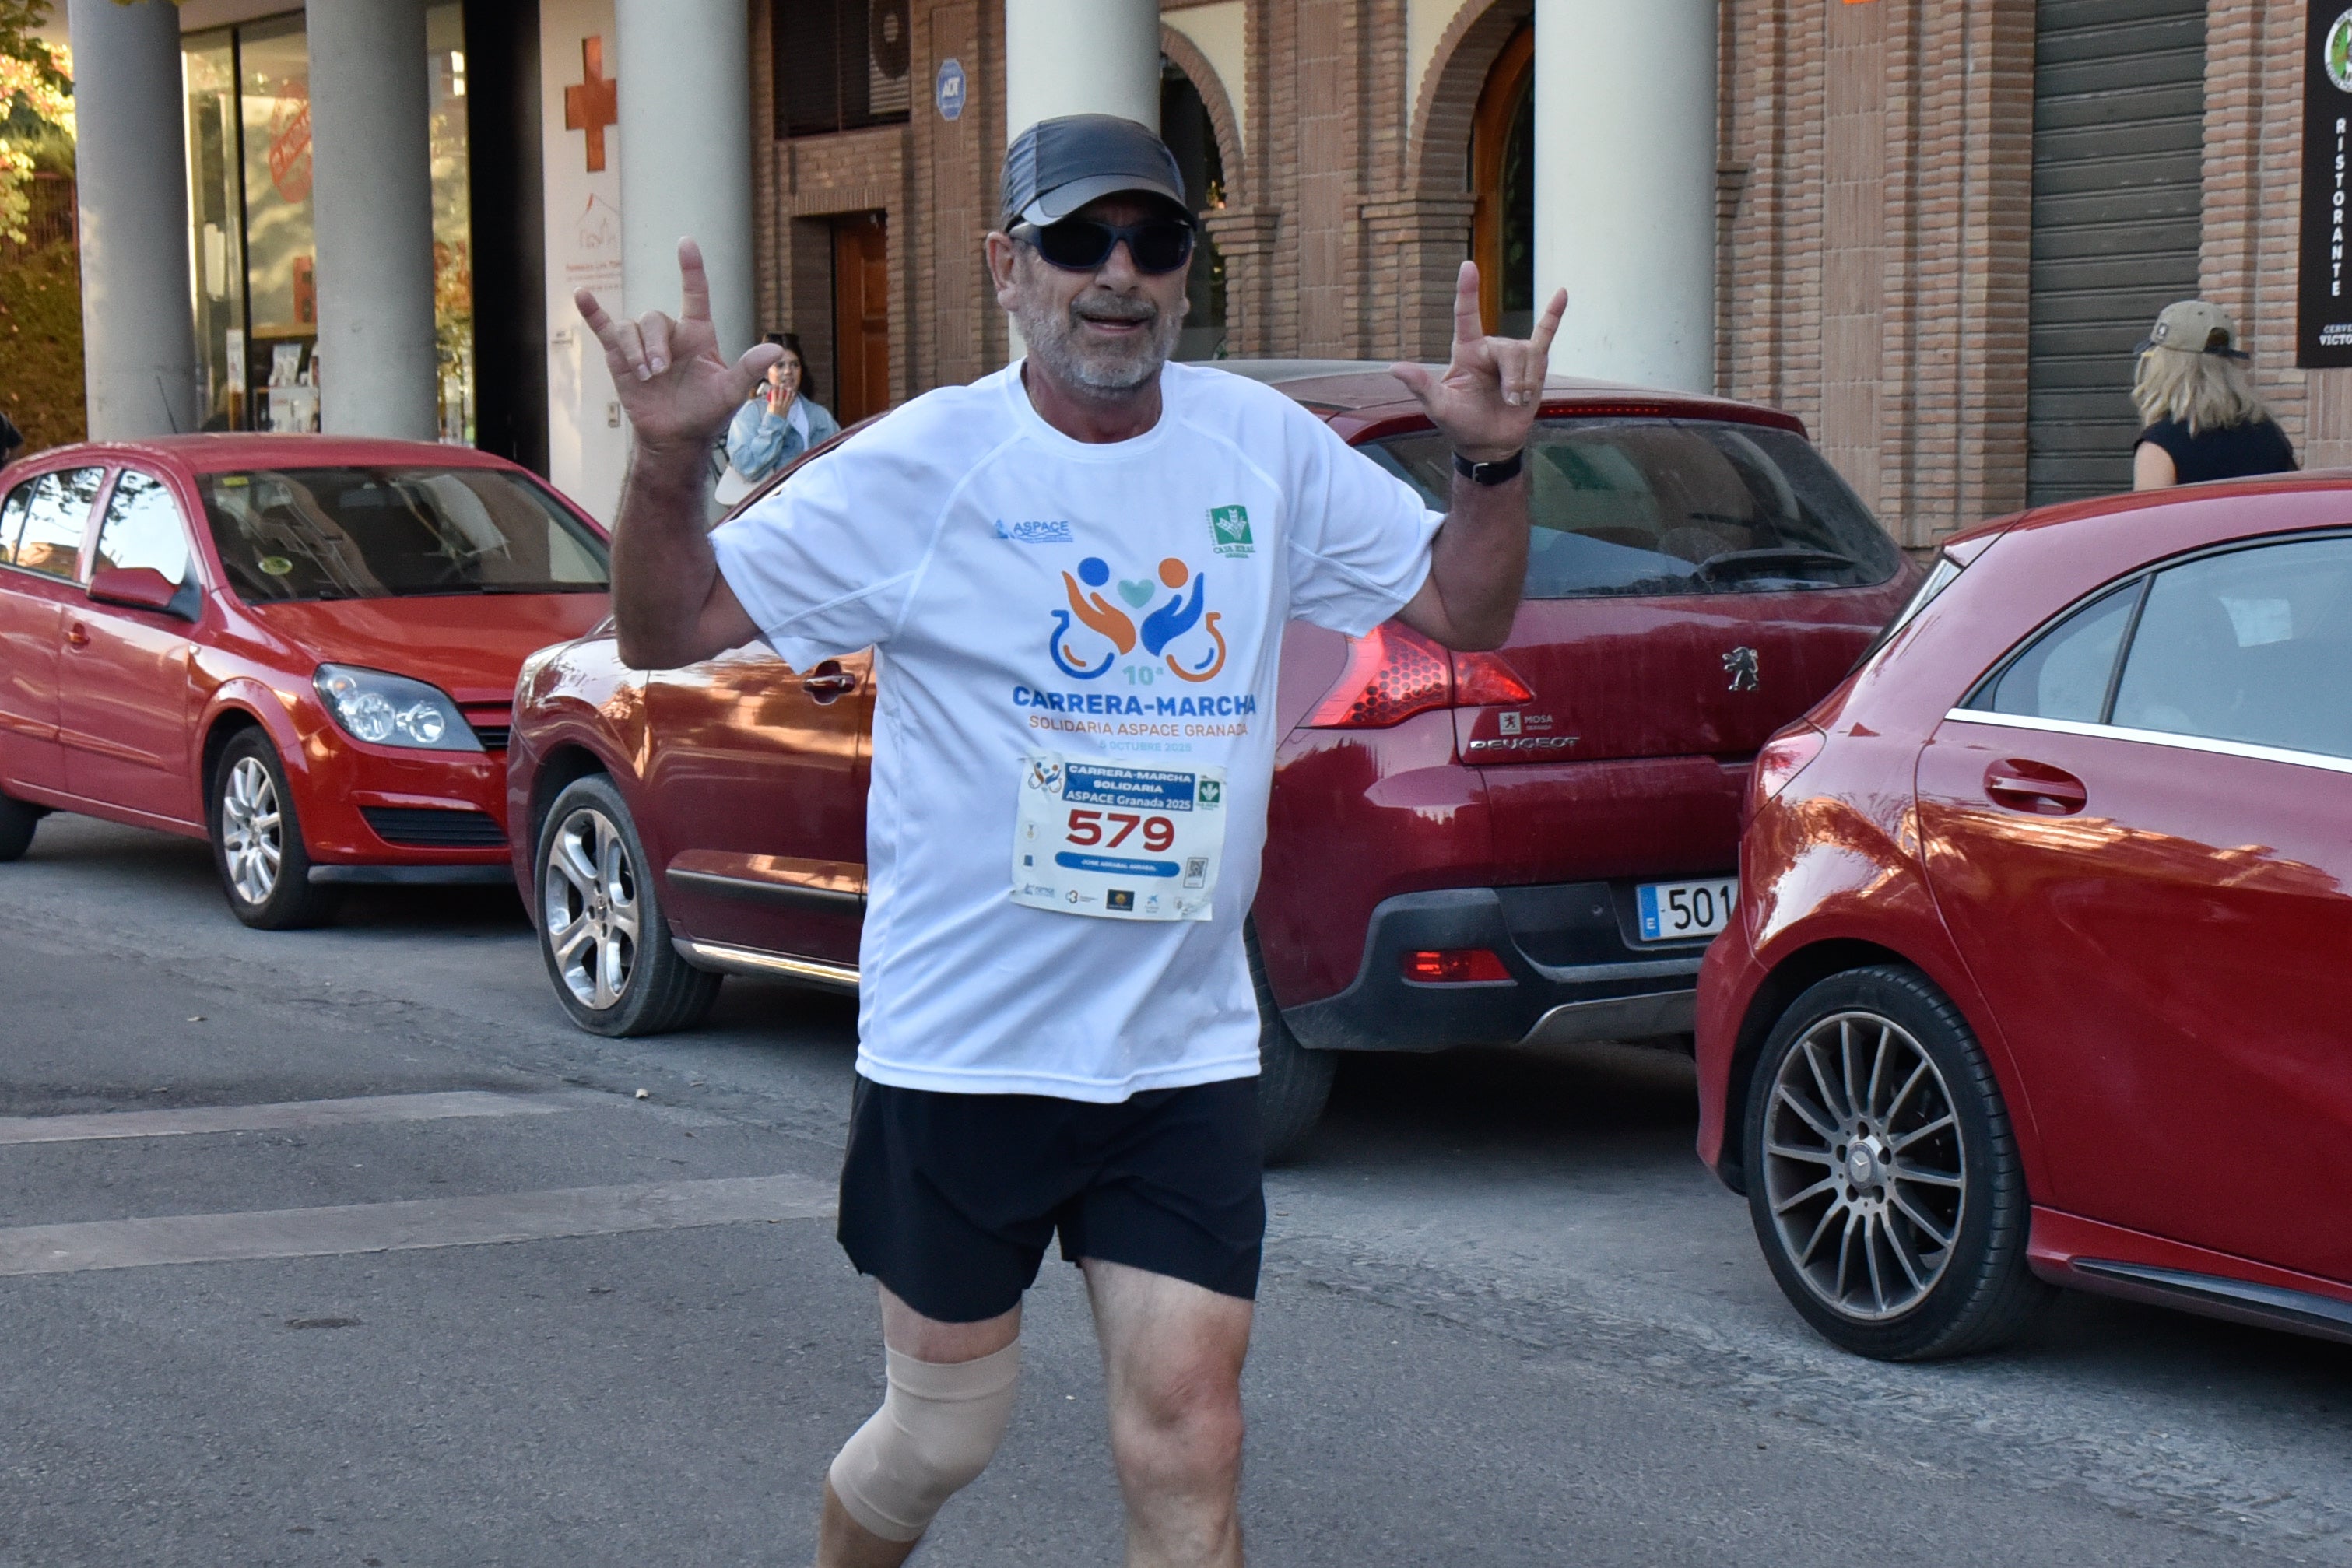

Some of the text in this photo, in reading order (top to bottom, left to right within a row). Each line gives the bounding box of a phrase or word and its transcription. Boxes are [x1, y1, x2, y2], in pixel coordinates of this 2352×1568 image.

[943, 77, 960, 98] ADT
[2332, 118, 2347, 296] RISTORANTE
[1013, 521, 1069, 532] ASPACE
[1013, 686, 1256, 717] CARRERA-MARCHA
[1029, 715, 1114, 735] SOLIDARIA
[1117, 723, 1180, 738] ASPACE
[1525, 714, 1553, 724] MOSA
[1109, 741, 1162, 752] OCTUBRE
[1165, 742, 1192, 752] 2025
[1469, 737, 1580, 749] PEUGEOT
[1069, 765, 1192, 783] CARRERA-MARCHA
[1094, 780, 1164, 794] SOLIDARIA
[1066, 790, 1114, 804] ASPACE
[1116, 795, 1164, 809] Granada
[1167, 798, 1192, 810] 2025
[1065, 809, 1174, 852] 579
[1646, 917, 1656, 929] E
